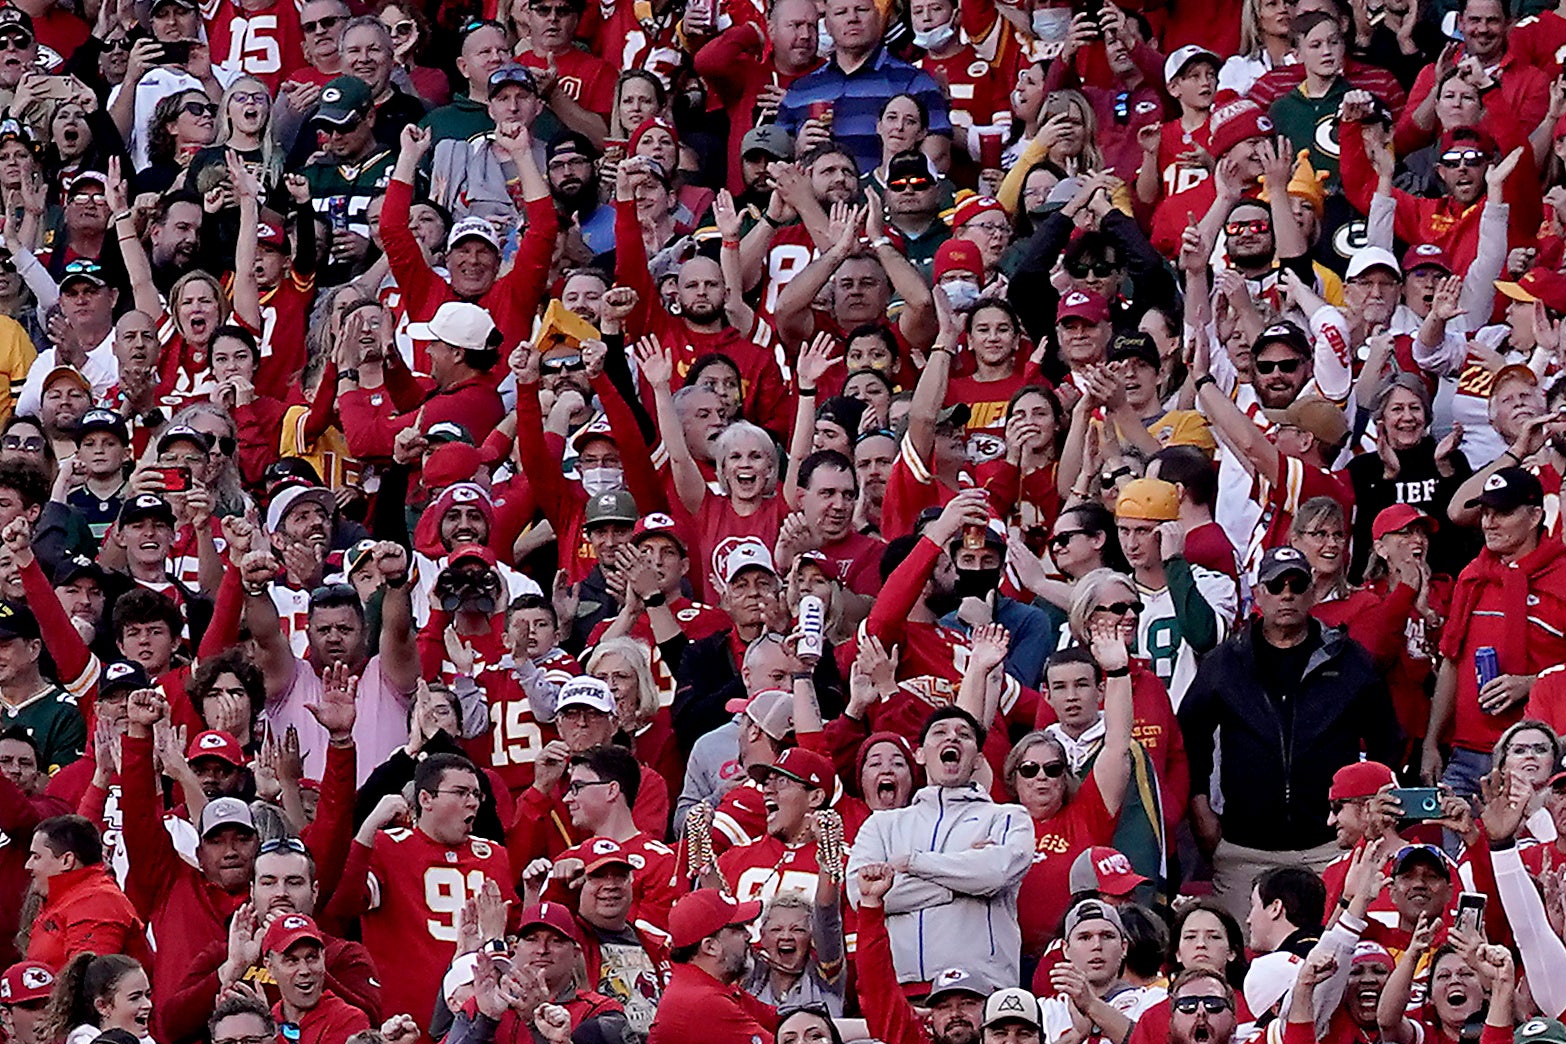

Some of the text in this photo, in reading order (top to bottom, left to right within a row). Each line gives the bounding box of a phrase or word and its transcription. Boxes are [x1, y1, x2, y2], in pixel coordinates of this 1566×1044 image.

[221, 15, 281, 73] 15
[1395, 478, 1438, 503] IEF
[490, 700, 543, 768] 15
